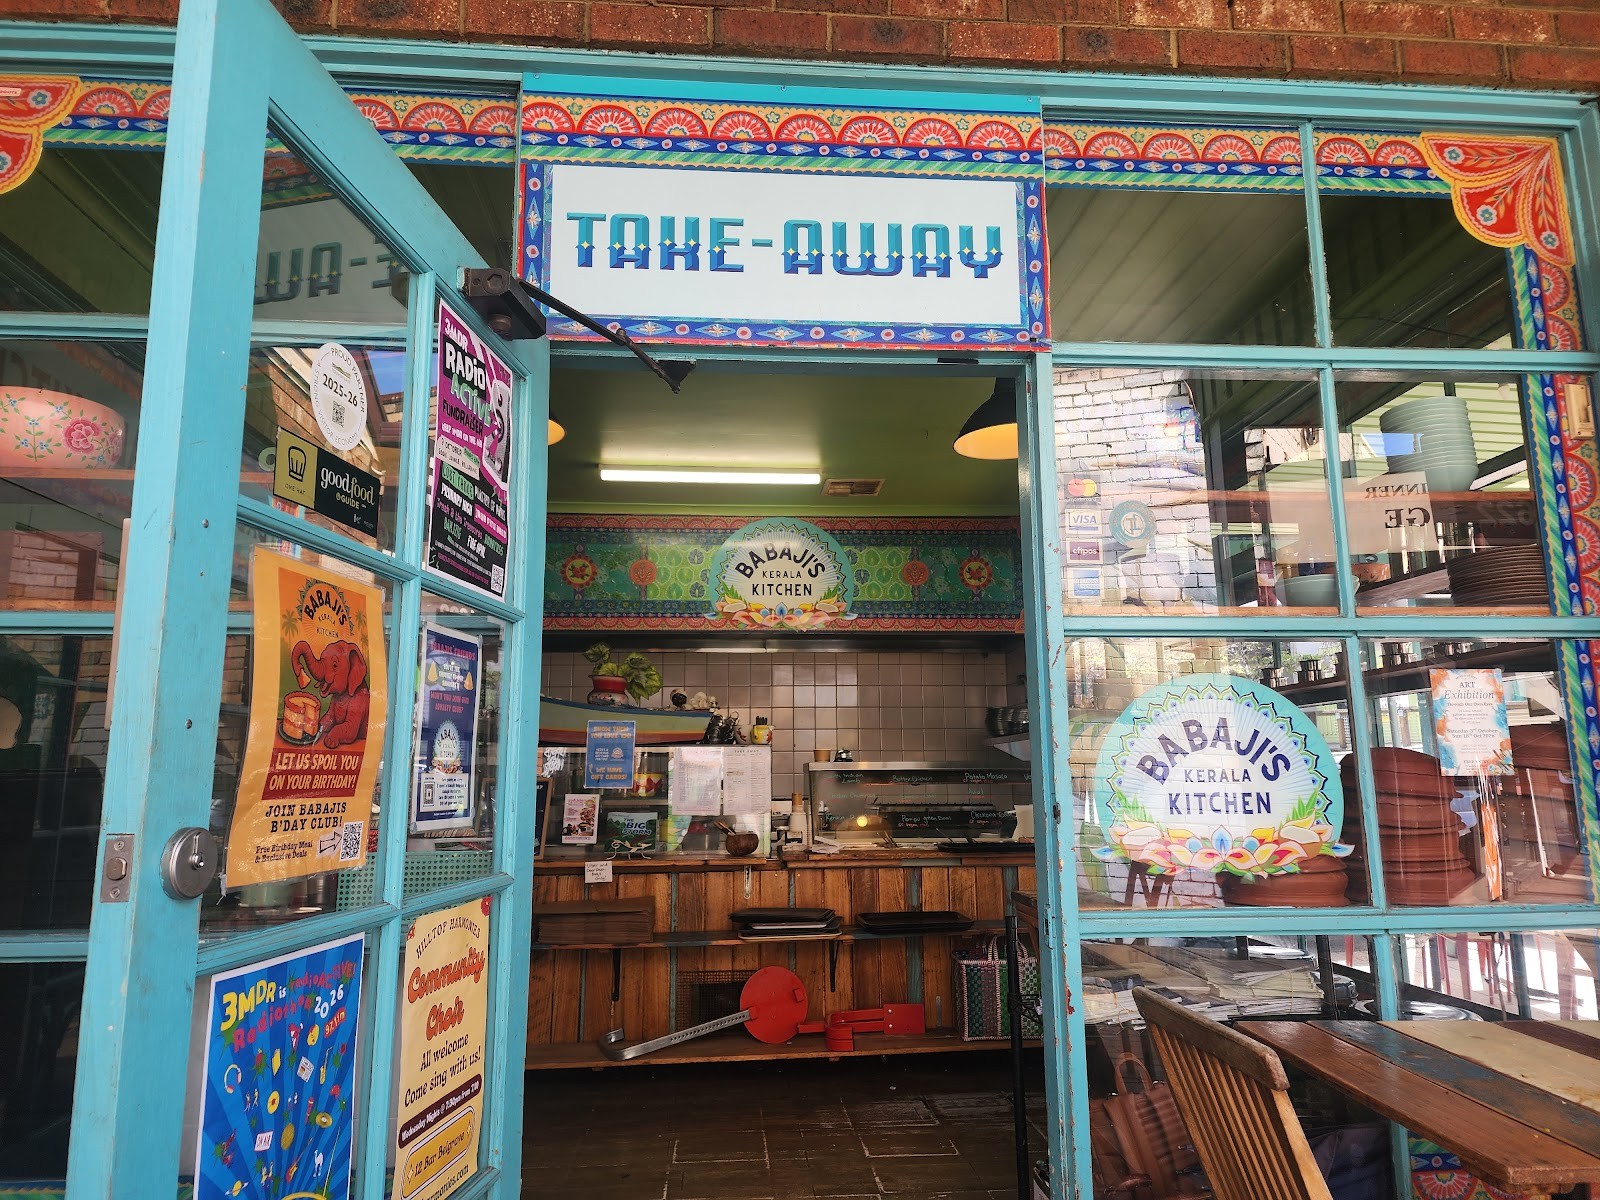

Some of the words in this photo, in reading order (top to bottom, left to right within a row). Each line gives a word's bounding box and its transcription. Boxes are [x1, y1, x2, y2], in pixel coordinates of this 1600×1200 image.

[566, 212, 1003, 279] TAKE-AWAY
[444, 317, 468, 353] 3MDR
[330, 347, 352, 366] PROUD
[322, 373, 358, 407] 2025-26
[351, 366, 366, 413] PARTNER
[284, 483, 295, 492] ONE
[1073, 515, 1097, 524] VISA
[734, 542, 826, 579] BABAJI'S
[1072, 546, 1098, 556] eftpos
[762, 570, 802, 579] KERALA
[752, 583, 812, 596] KITCHEN
[303, 589, 347, 626] BABAJI'S
[318, 613, 336, 627] KERALA
[316, 627, 339, 638] KITCHEN
[1444, 690, 1494, 700] Exhibition
[275, 752, 296, 770] LET
[295, 753, 311, 770] US
[310, 754, 338, 771] SPOIL
[340, 755, 359, 771] YOU
[1135, 717, 1291, 786] BABAJI'S
[268, 775, 286, 791] ON
[286, 774, 313, 790] YOUR
[312, 774, 356, 790] BIRTHDAY!
[1184, 768, 1252, 783] KERALA
[265, 804, 296, 818] JOIN
[298, 802, 347, 816] BABAJIS
[1168, 792, 1272, 815] KITCHEN
[270, 818, 307, 833] B'DAY
[310, 815, 343, 829] CLUB!
[255, 845, 270, 854] Free
[271, 843, 298, 852] Birthday
[298, 841, 313, 849] Meal
[261, 852, 292, 862] Exclusive
[292, 849, 307, 859] Deals
[415, 920, 448, 960] HILLTOP
[449, 916, 481, 940] HARMONIES
[407, 946, 486, 1004] Community
[220, 979, 276, 1032] 3MDR
[278, 986, 287, 999] is
[233, 994, 313, 1054] Radiothon
[314, 983, 344, 1019] 2026
[426, 995, 465, 1041] Choir
[420, 1048, 432, 1072] All
[433, 1033, 469, 1063] welcome
[404, 1082, 428, 1108] Come
[429, 1069, 448, 1091] sing
[449, 1054, 467, 1078] with
[469, 1044, 481, 1067] us!
[401, 1119, 427, 1142] Wednesday
[426, 1108, 440, 1124] Nights
[256, 1135, 263, 1148] ON
[262, 1134, 271, 1147] AIR
[414, 1158, 423, 1178] 12
[423, 1153, 437, 1170] Bar
[437, 1131, 465, 1159] Belgrave
